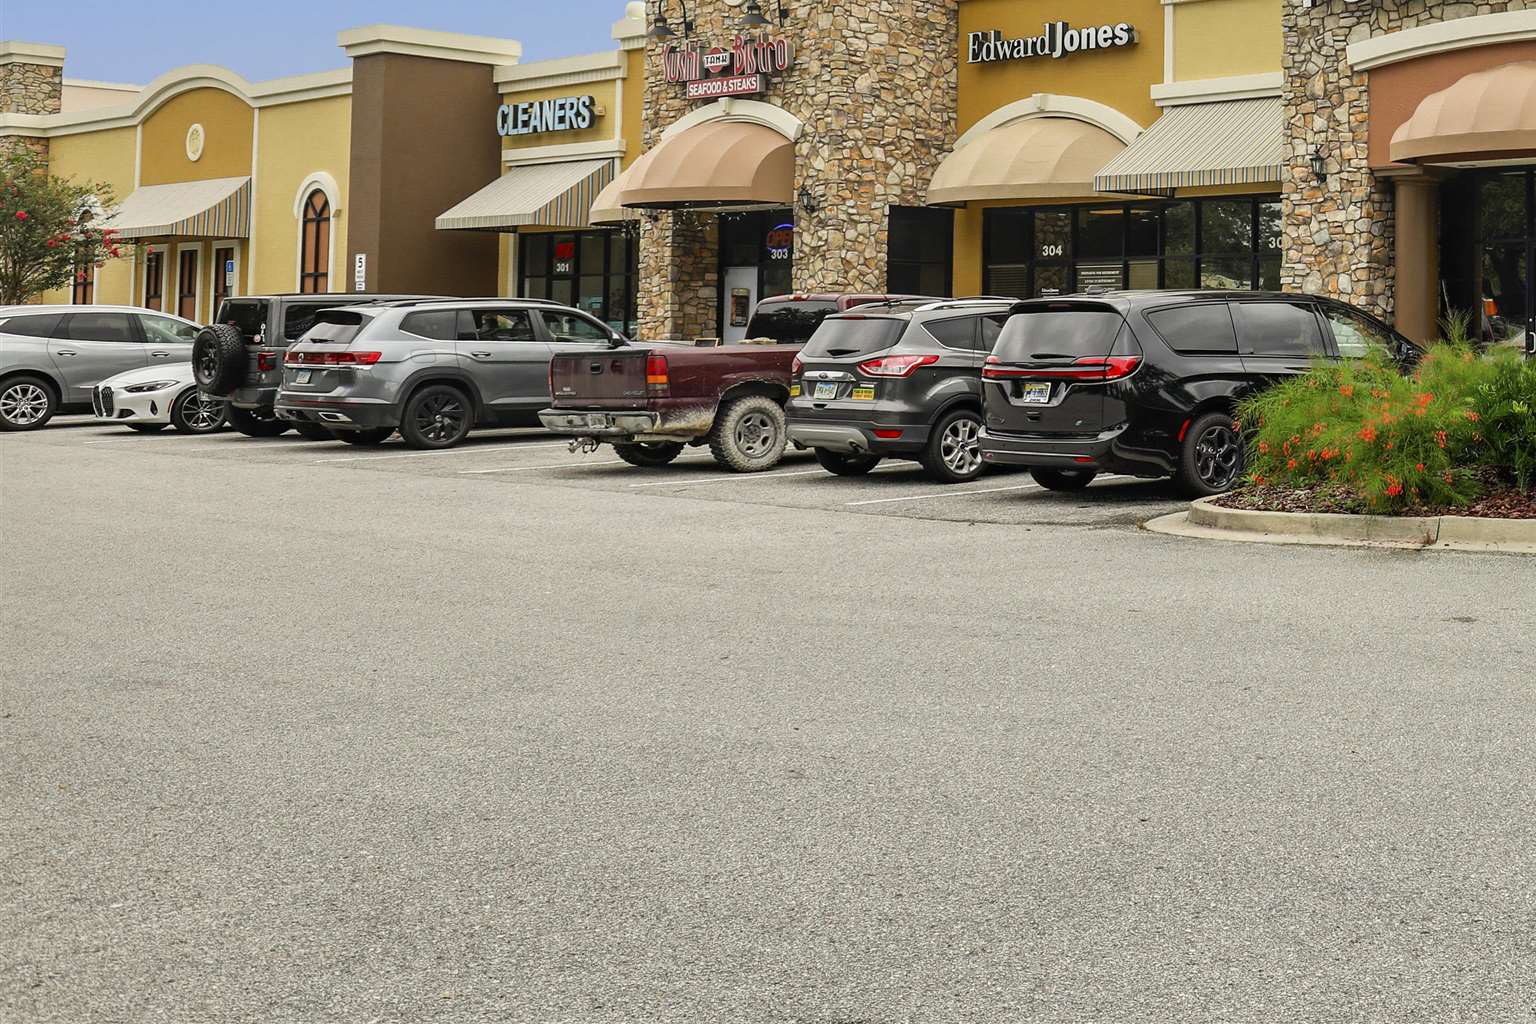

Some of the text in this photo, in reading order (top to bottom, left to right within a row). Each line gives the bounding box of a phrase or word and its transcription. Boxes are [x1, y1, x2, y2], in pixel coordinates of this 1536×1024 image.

[966, 21, 1129, 64] Edward Jones
[663, 40, 700, 82] Sushi
[732, 32, 789, 76] Bistro
[689, 77, 757, 96] SEAFOOD & STEAKS
[496, 95, 592, 136] CLEANERS
[1269, 237, 1282, 249] 30
[770, 249, 788, 259] 303
[1042, 245, 1063, 256] 304
[357, 257, 363, 268] 5
[556, 263, 569, 272] 301
